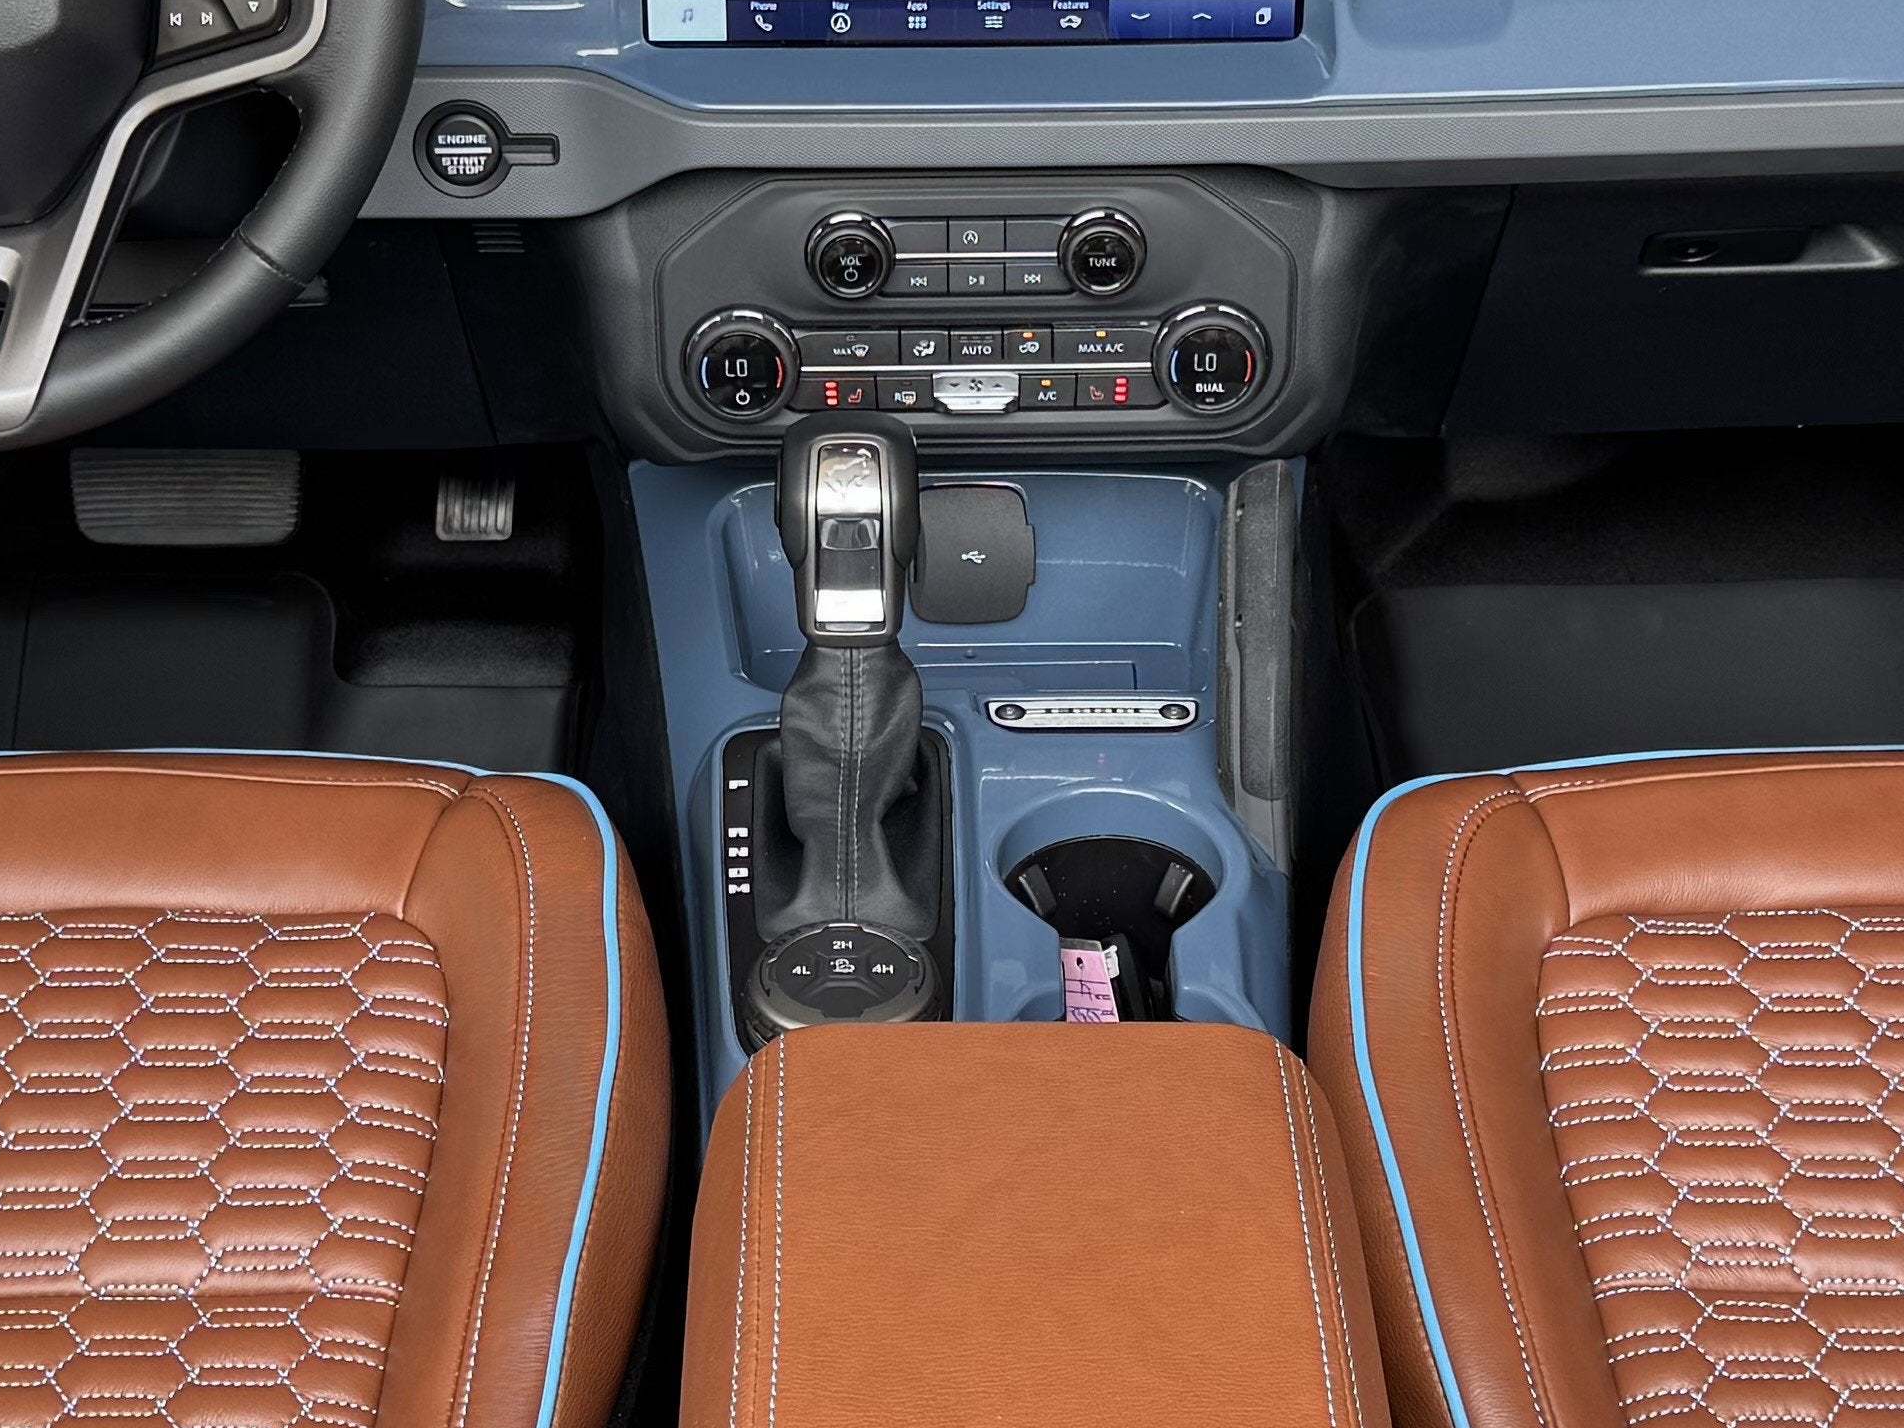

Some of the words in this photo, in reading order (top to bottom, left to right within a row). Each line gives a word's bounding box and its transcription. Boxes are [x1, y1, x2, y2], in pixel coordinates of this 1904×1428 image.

[750, 0, 778, 12] Phone
[832, 0, 850, 12] Nav
[906, 0, 928, 13] Apps
[977, 0, 1012, 12] Settings
[1052, 0, 1090, 12] Features
[437, 134, 487, 145] ENGINE
[441, 156, 487, 167] START
[447, 164, 484, 176] STOP
[839, 256, 862, 267] VOL
[1088, 256, 1118, 268] TUNE
[961, 344, 993, 356] AUTO
[1078, 342, 1103, 354] MAX
[1105, 342, 1124, 354] A/C
[1195, 382, 1226, 394] DUAL
[1037, 390, 1058, 402] A/C
[832, 940, 854, 951] 2H
[792, 965, 811, 975] 4L
[871, 964, 894, 975] 4H
